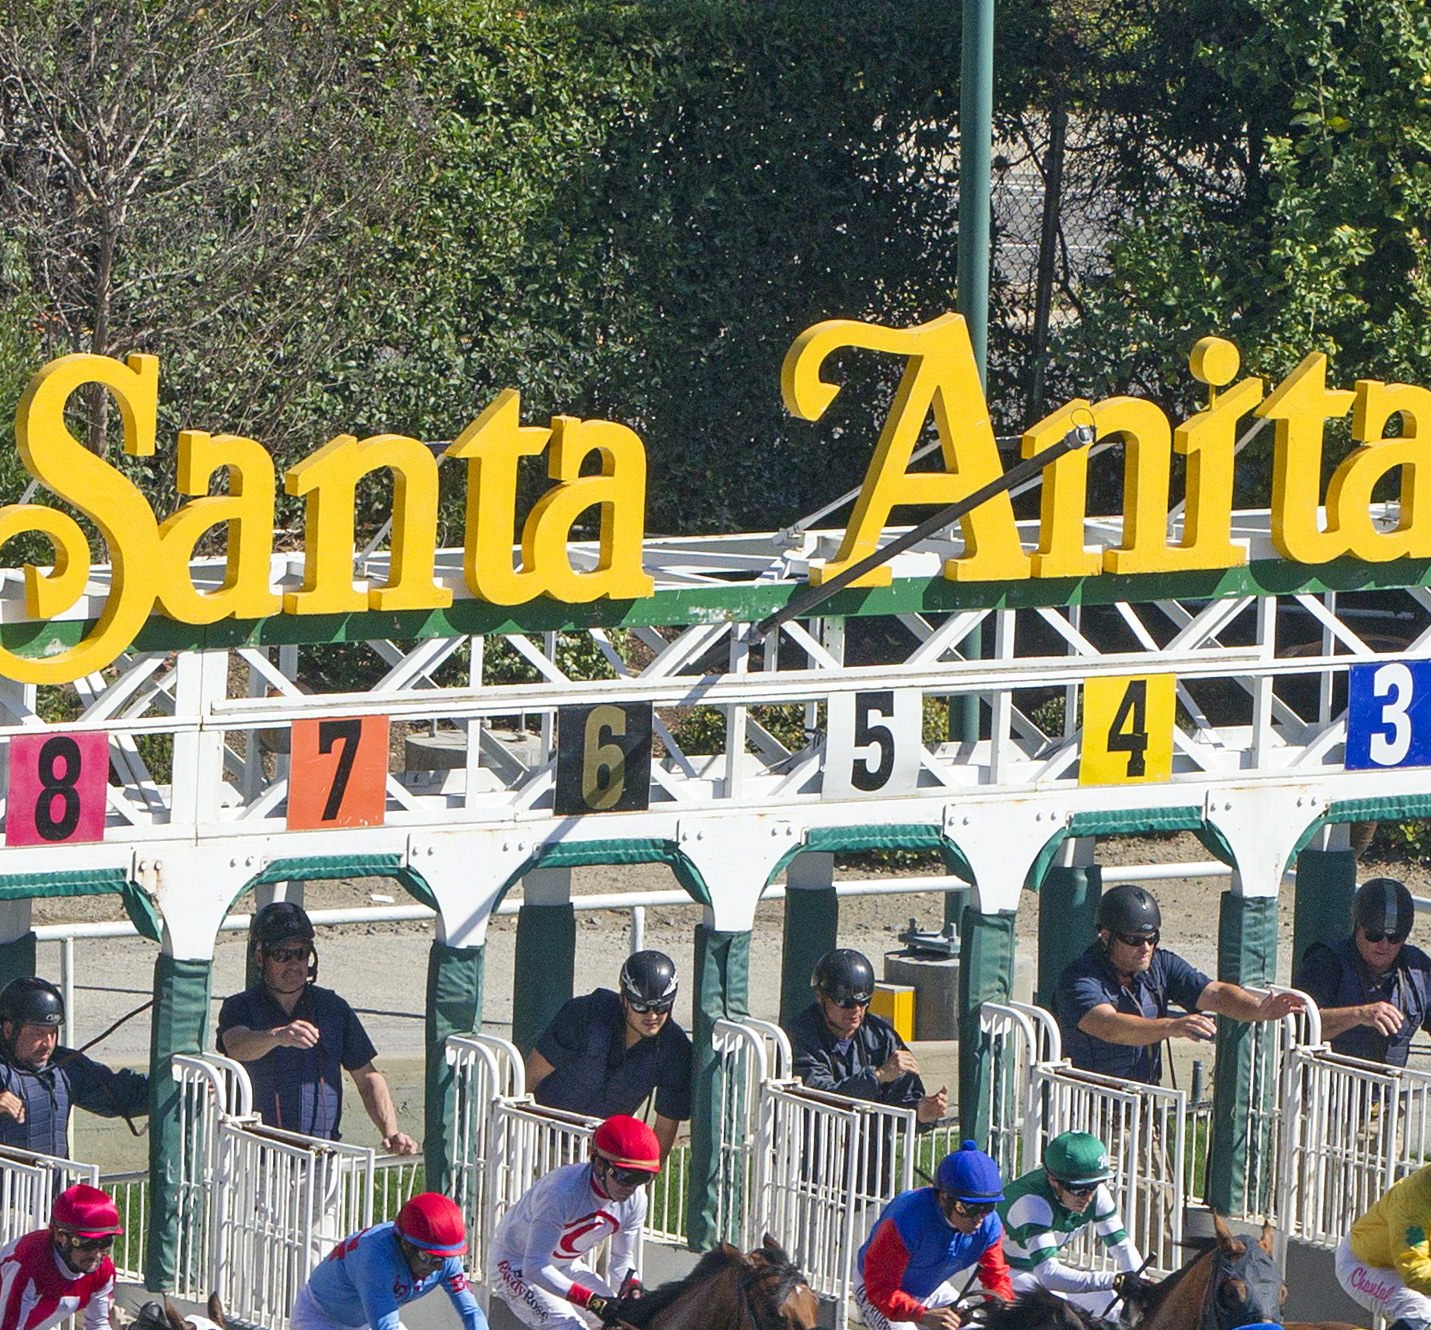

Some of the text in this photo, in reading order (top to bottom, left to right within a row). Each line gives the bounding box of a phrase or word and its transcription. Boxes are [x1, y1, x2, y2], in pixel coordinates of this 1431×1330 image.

[581, 704, 627, 810] 6
[851, 690, 896, 792] 5
[1106, 679, 1149, 777] 4
[1369, 662, 1415, 768] 3
[35, 735, 83, 842] 8
[317, 718, 363, 822] 7
[523, 1289, 550, 1324] Rose
